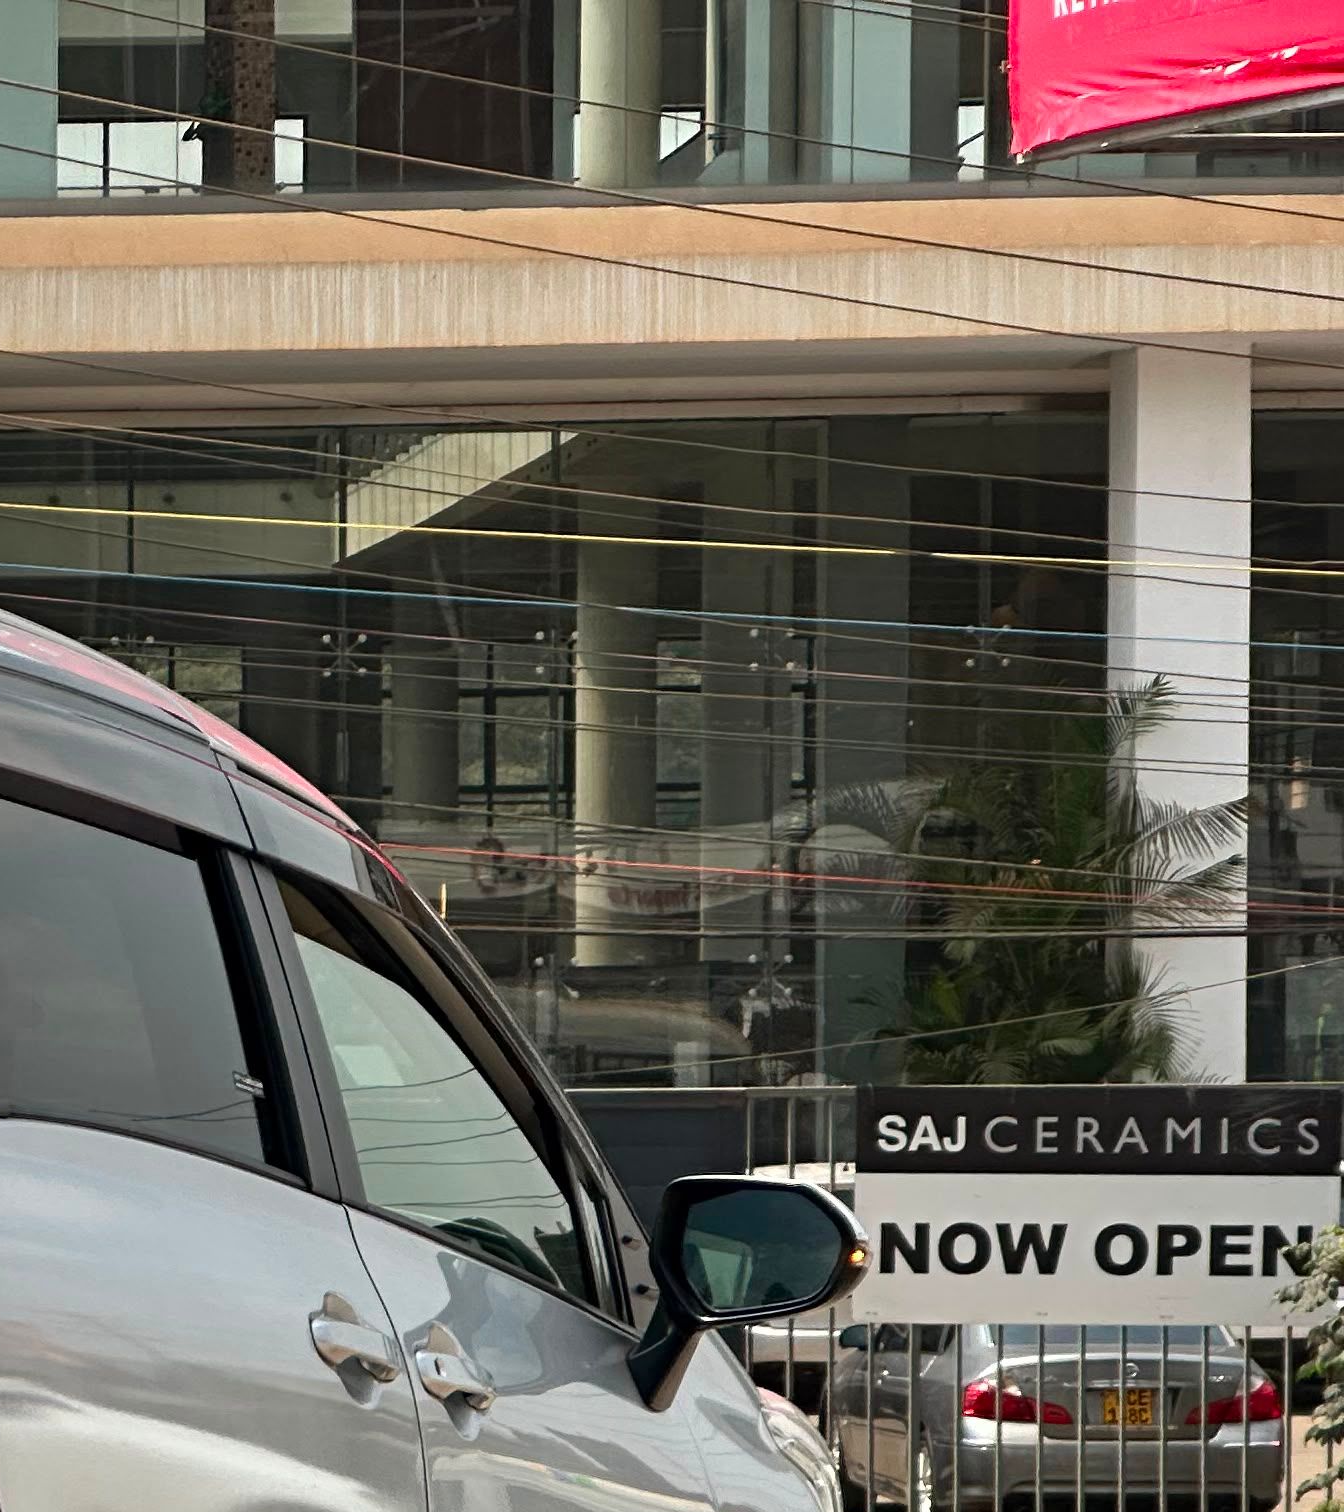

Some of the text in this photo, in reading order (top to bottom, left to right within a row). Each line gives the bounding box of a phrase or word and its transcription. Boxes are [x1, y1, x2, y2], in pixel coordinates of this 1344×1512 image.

[876, 1114, 1321, 1156] SAJ CERAMICS
[879, 1222, 1314, 1278] NOW OPEN
